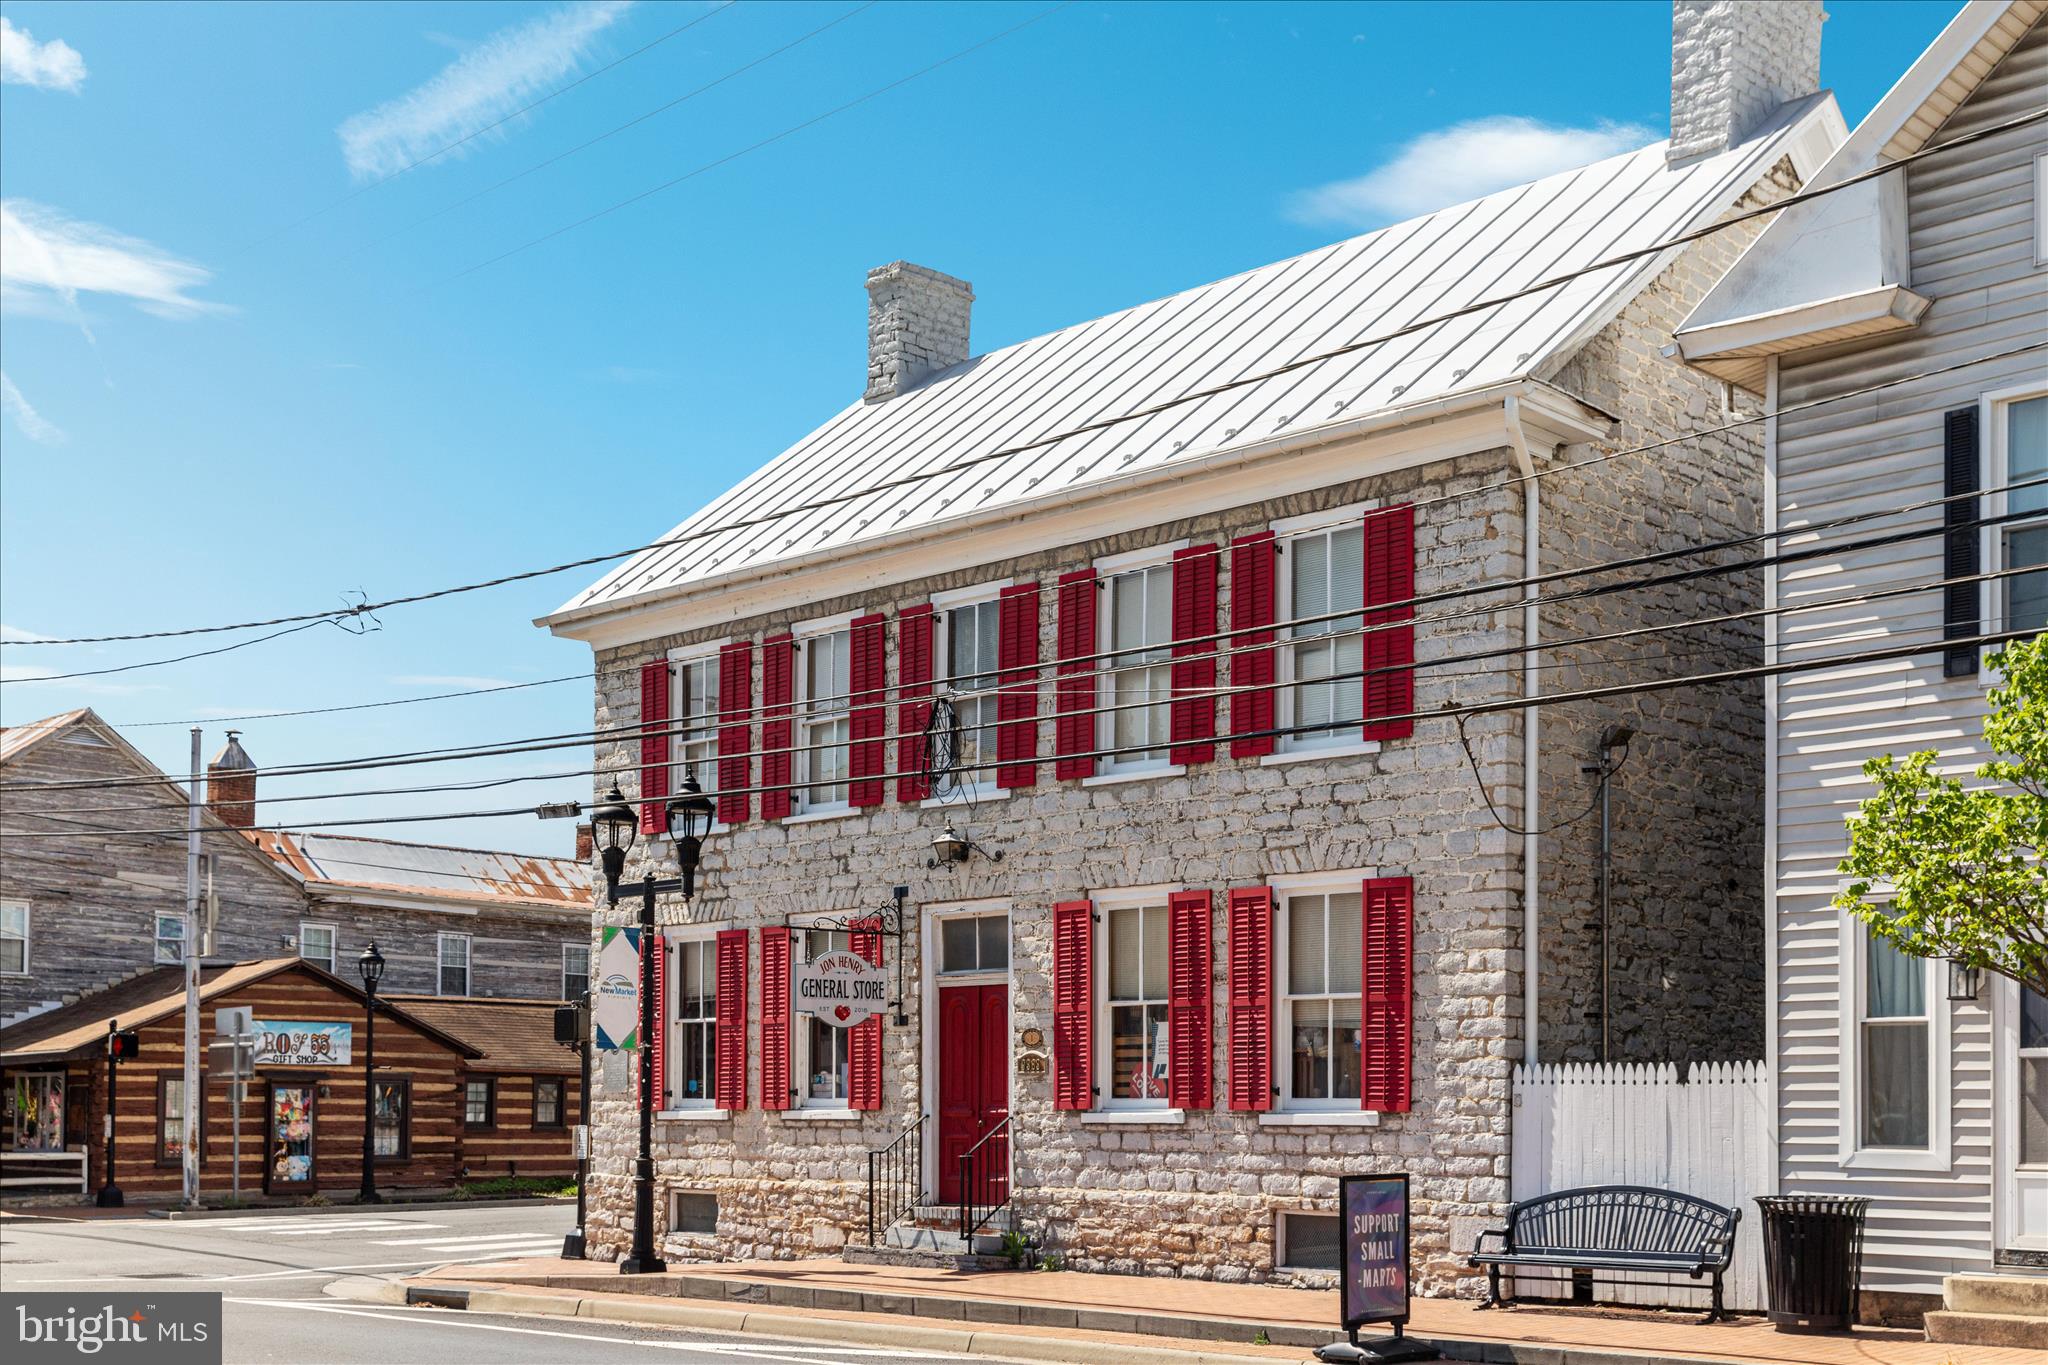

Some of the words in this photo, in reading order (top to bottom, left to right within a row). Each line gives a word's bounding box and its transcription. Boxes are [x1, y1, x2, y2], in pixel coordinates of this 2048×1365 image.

[819, 957, 836, 975] JON
[838, 956, 866, 975] HENRY
[801, 978, 849, 998] GENERAL
[853, 980, 885, 1000] STORE
[272, 1055, 292, 1064] GIFT
[296, 1055, 318, 1064] SHOP
[1353, 1213, 1400, 1234] SUPPORT
[1361, 1240, 1395, 1260] SMALL
